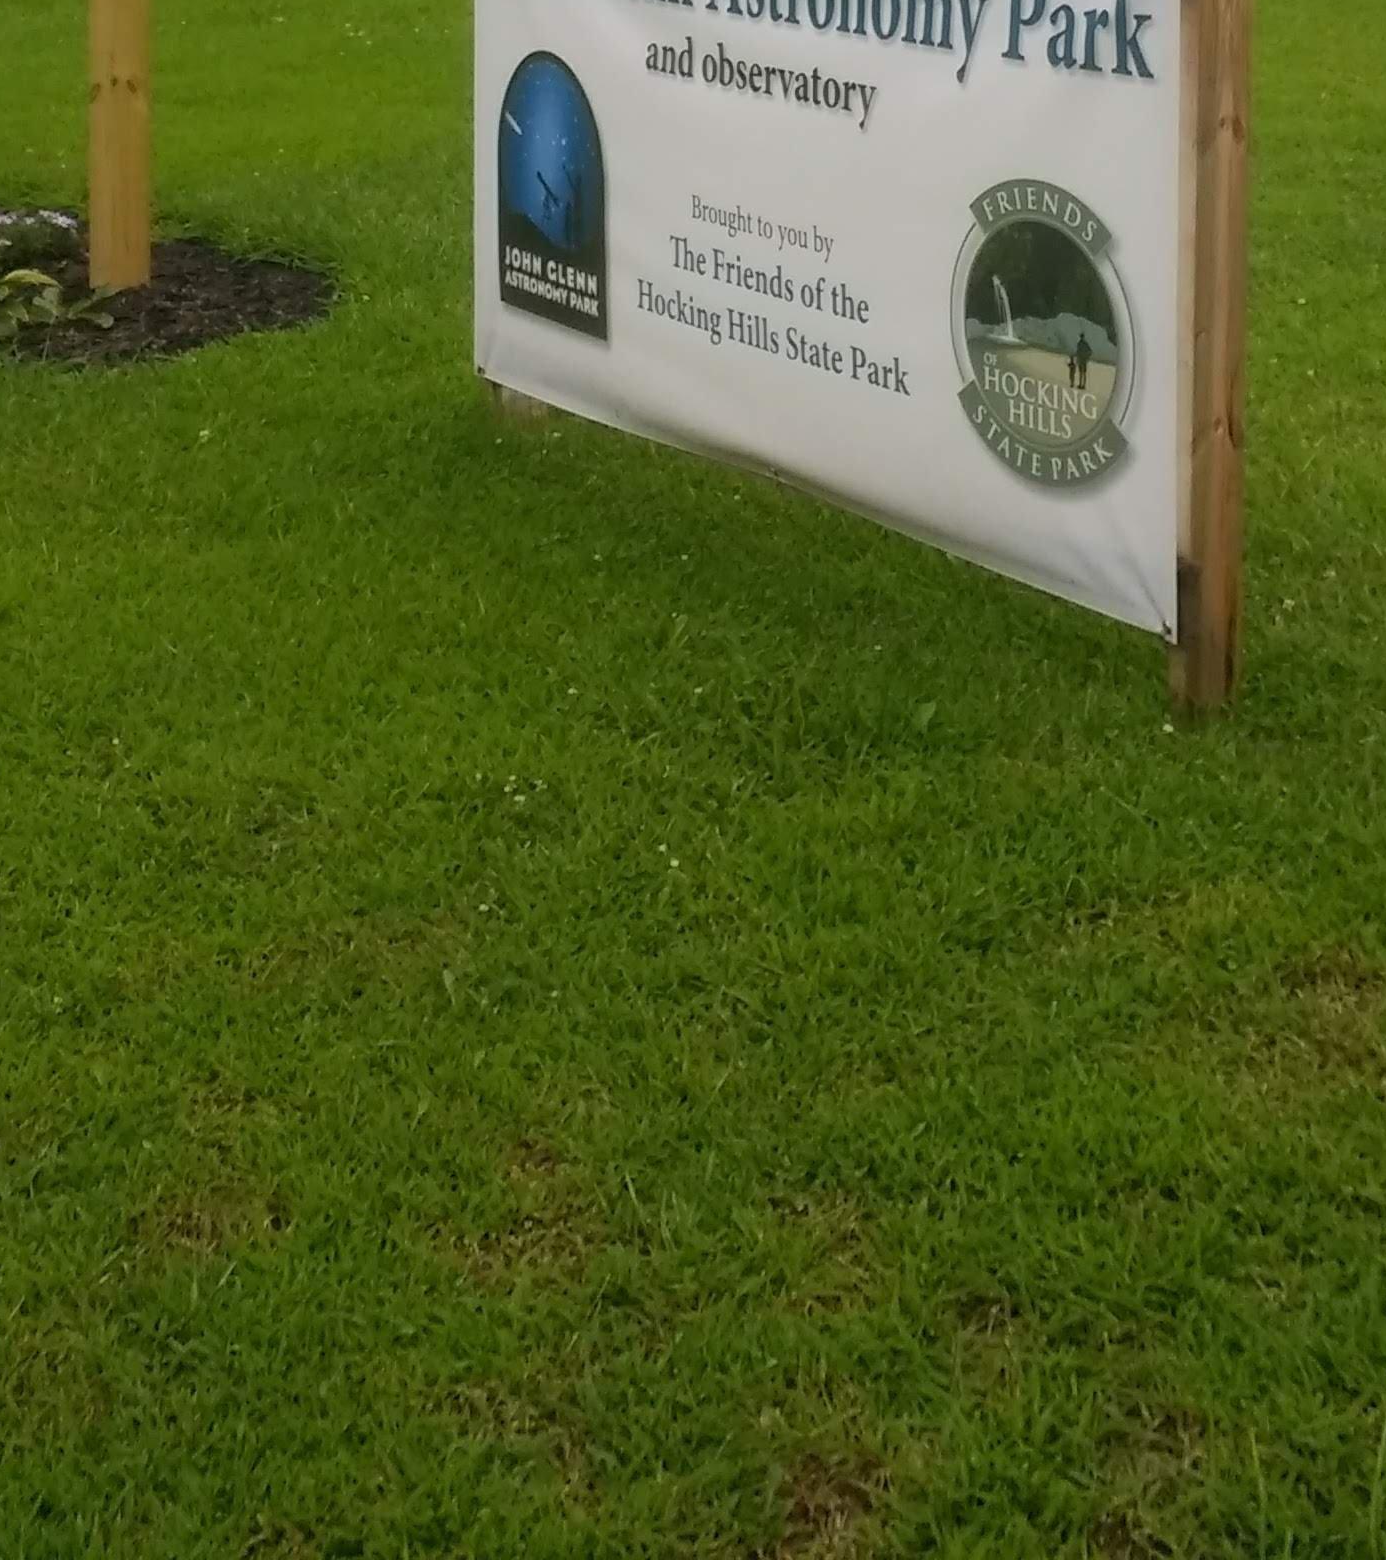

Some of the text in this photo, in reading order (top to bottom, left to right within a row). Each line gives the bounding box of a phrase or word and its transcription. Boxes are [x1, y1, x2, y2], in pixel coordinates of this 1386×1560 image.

[645, 36, 877, 130] and observatory
[691, 194, 834, 263] Brought to you by
[982, 187, 1098, 242] FRIENDS
[505, 245, 598, 297] JOHN GLENN
[505, 269, 599, 317] ASTRONOMY PARK
[670, 235, 869, 324] The Friends of the
[637, 278, 911, 396] Hocking Hills State Park
[983, 352, 998, 366] OF
[983, 366, 1097, 419] HOCKING
[1009, 399, 1072, 439] HILLS
[973, 405, 1113, 480] STATE PARK
